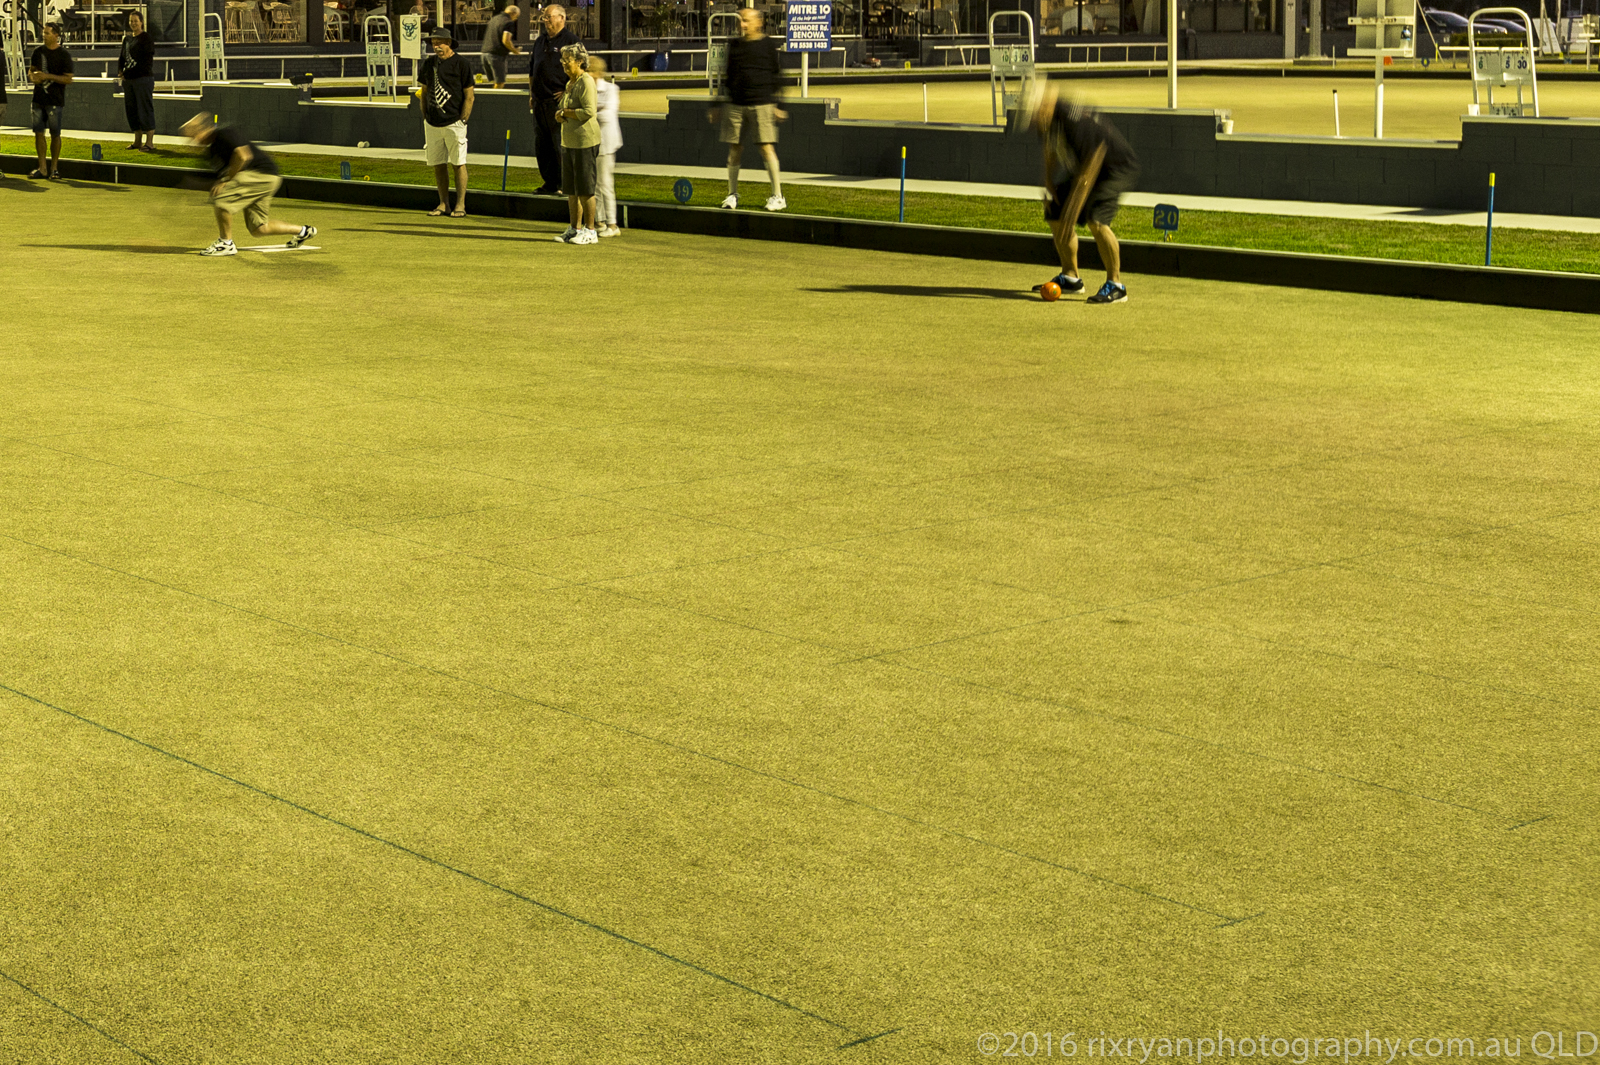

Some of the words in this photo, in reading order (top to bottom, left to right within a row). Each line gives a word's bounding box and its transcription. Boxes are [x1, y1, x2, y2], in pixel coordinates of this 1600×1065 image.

[789, 4, 817, 14] MITRE
[819, 4, 831, 14] 10
[1478, 59, 1484, 69] 6
[1505, 59, 1511, 69] 5
[1517, 59, 1528, 69] 30
[677, 185, 690, 198] 19
[1155, 210, 1177, 226] 20
